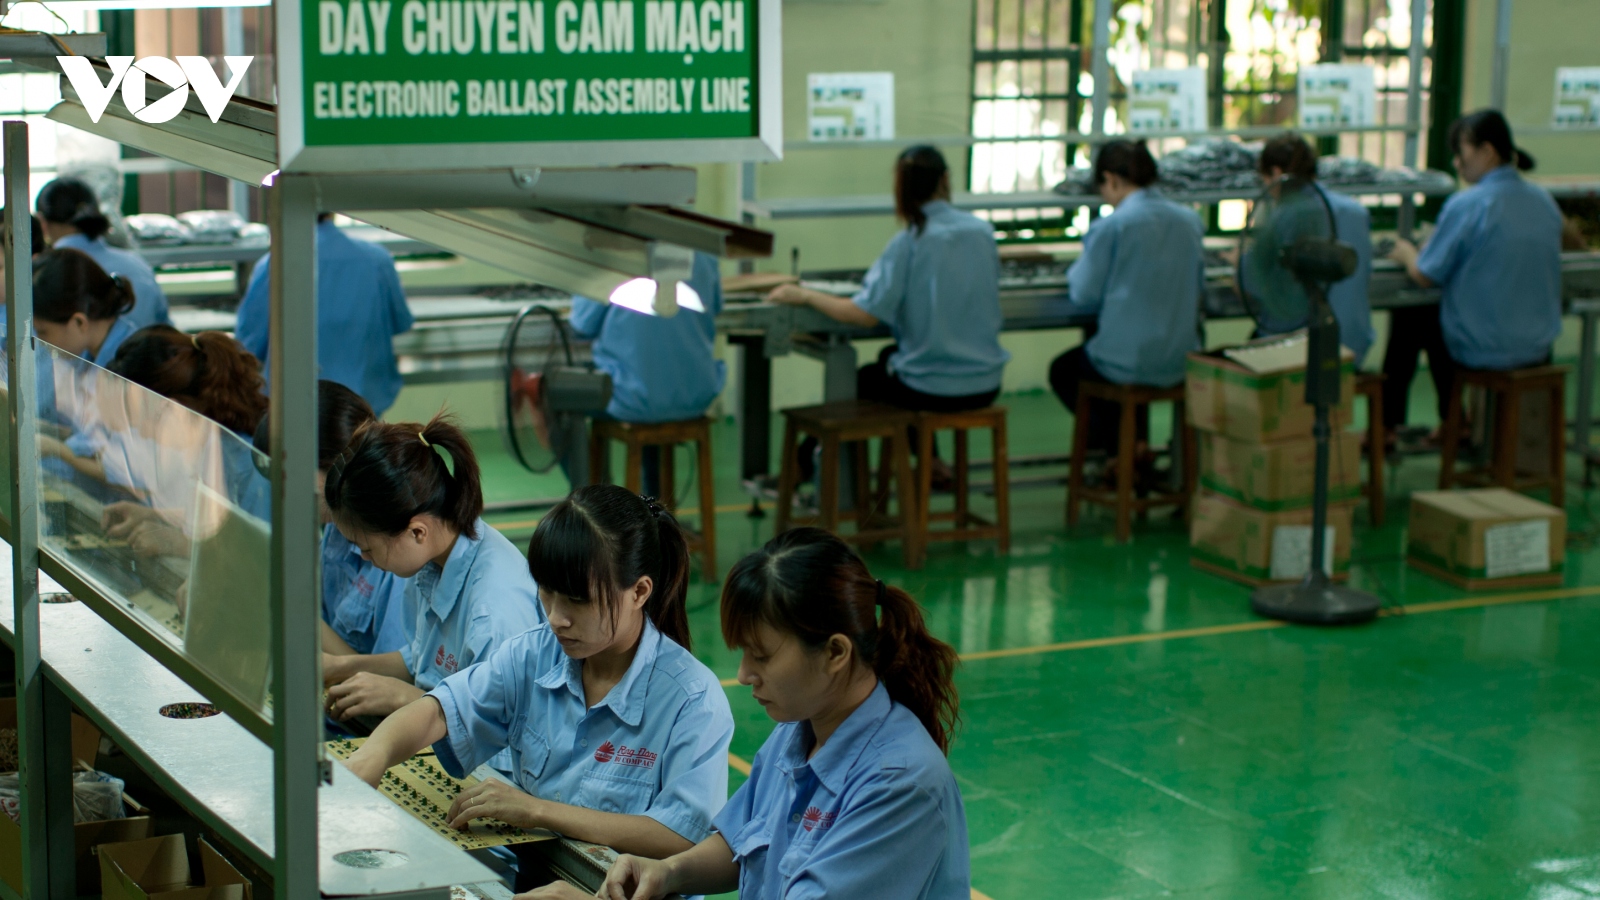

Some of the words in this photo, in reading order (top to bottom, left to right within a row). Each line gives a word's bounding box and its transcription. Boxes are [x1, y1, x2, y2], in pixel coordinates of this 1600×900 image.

[313, 80, 460, 118] ELECTRONIC
[466, 79, 567, 116] BALLAST
[573, 77, 695, 114] ASSEMBLY
[701, 77, 750, 113] LINE
